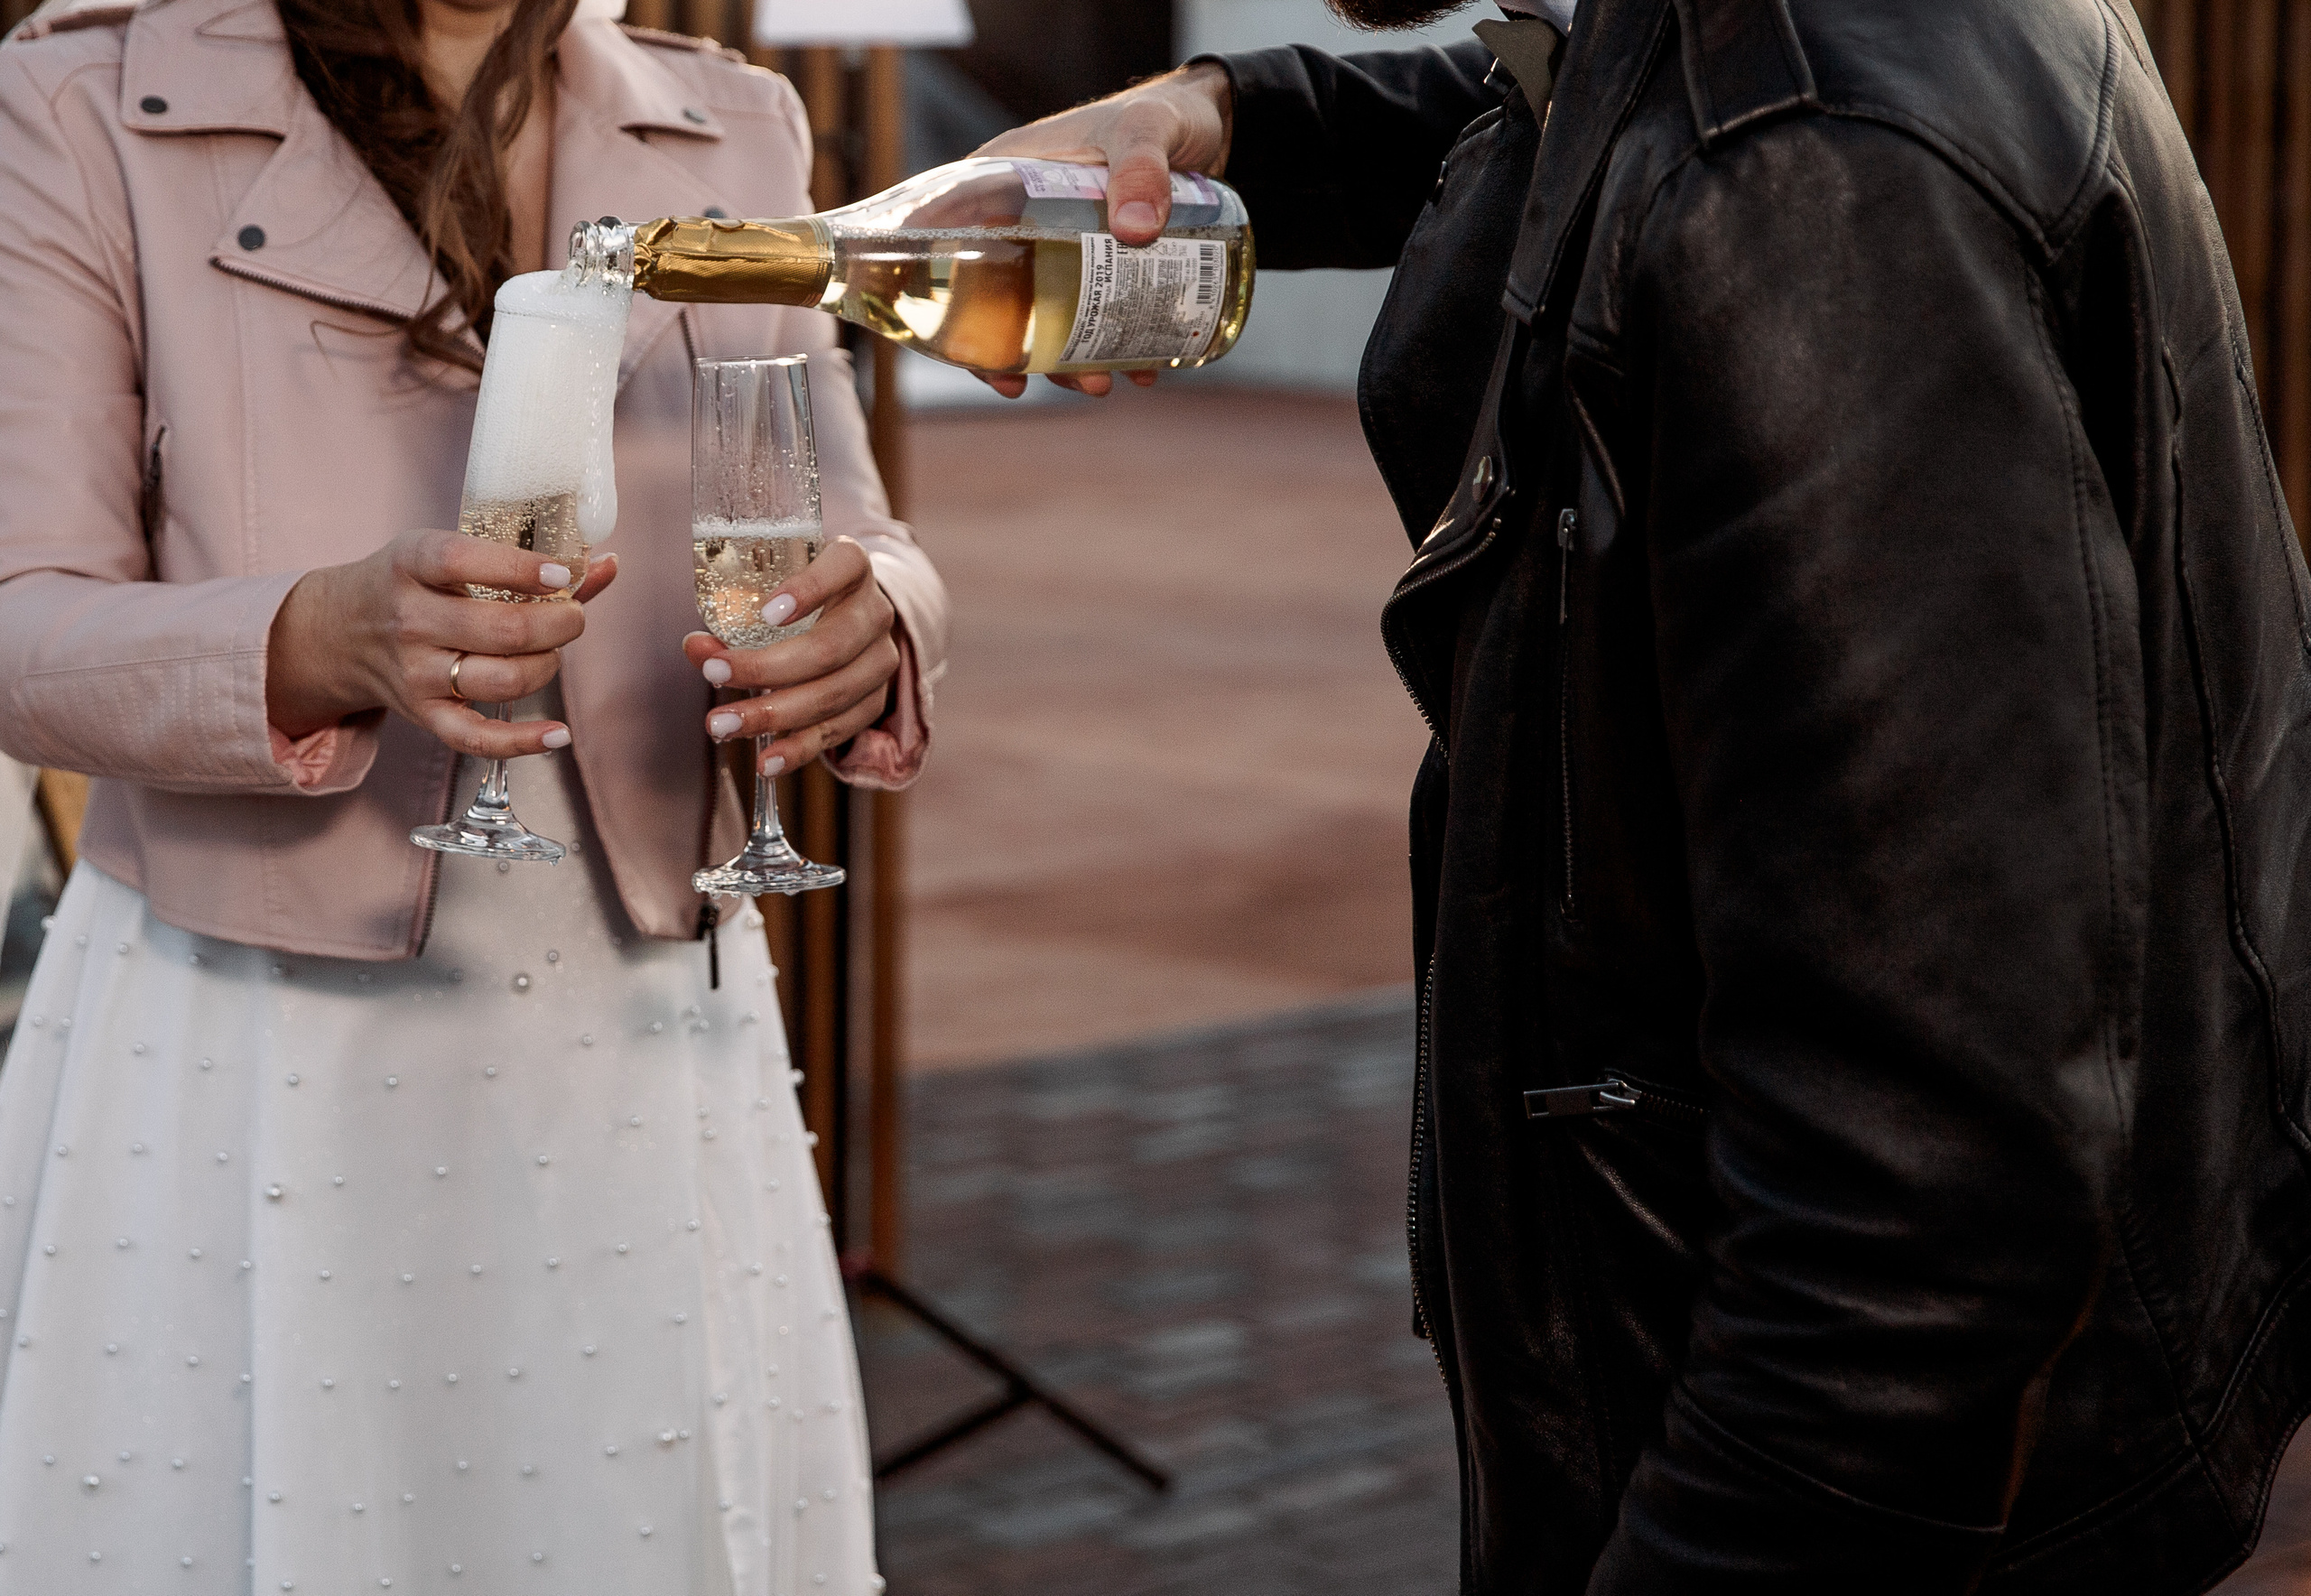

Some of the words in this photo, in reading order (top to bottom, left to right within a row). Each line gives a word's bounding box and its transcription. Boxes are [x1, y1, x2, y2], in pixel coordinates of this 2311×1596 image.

[1104, 237, 1113, 283] ИСПАНИЯ
[1095, 264, 1105, 288] 2019
[1087, 290, 1102, 328] УРОЖАЯ
[1081, 328, 1094, 343] ГОД
